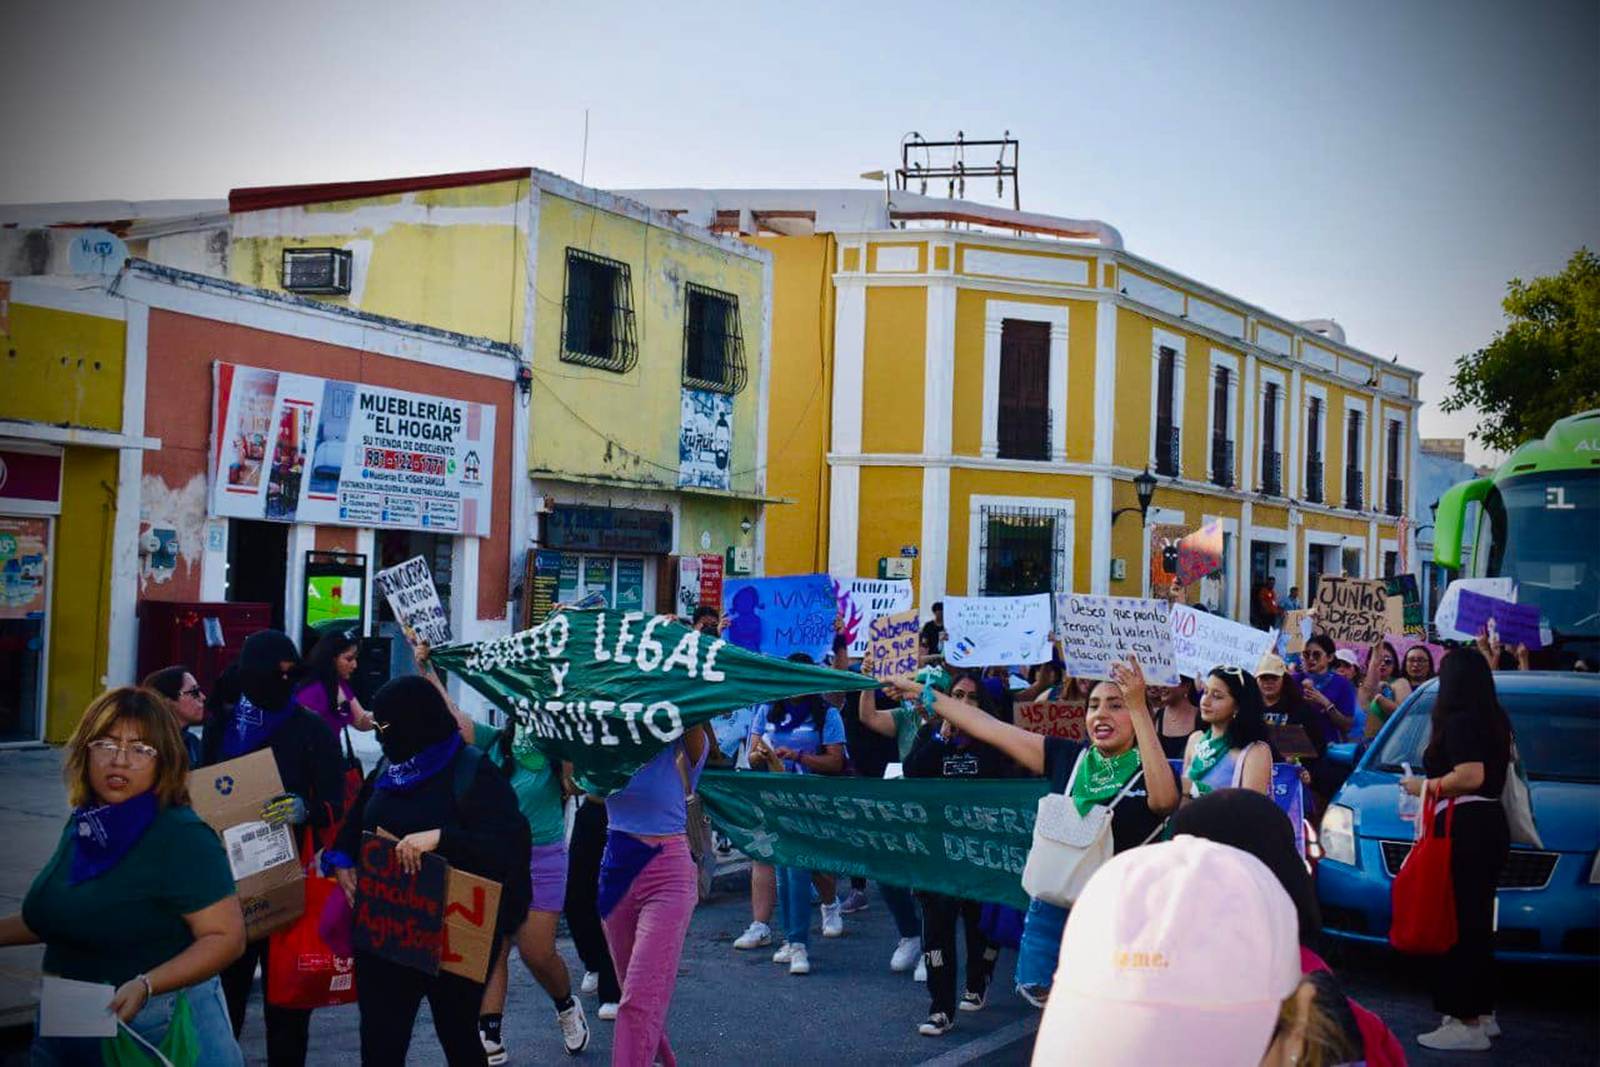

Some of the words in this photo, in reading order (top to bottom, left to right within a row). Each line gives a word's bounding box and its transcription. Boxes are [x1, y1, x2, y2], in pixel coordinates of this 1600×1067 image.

[360, 393, 462, 424] MUEBLERÍAS
[363, 435, 373, 446] SU
[374, 436, 401, 448] TIENDA
[403, 440, 413, 451] DE
[414, 442, 456, 456] DESCUENTO
[1070, 598, 1106, 618] Deseo
[1113, 608, 1132, 621] que
[1110, 622, 1121, 637] la
[1172, 609, 1196, 638] NO
[595, 611, 727, 682] LEGAL
[892, 637, 915, 656] que
[1064, 636, 1086, 647] para
[1116, 638, 1127, 651] de
[1132, 642, 1152, 653] esa
[550, 661, 570, 697] Y
[759, 790, 928, 824] NUESTRO
